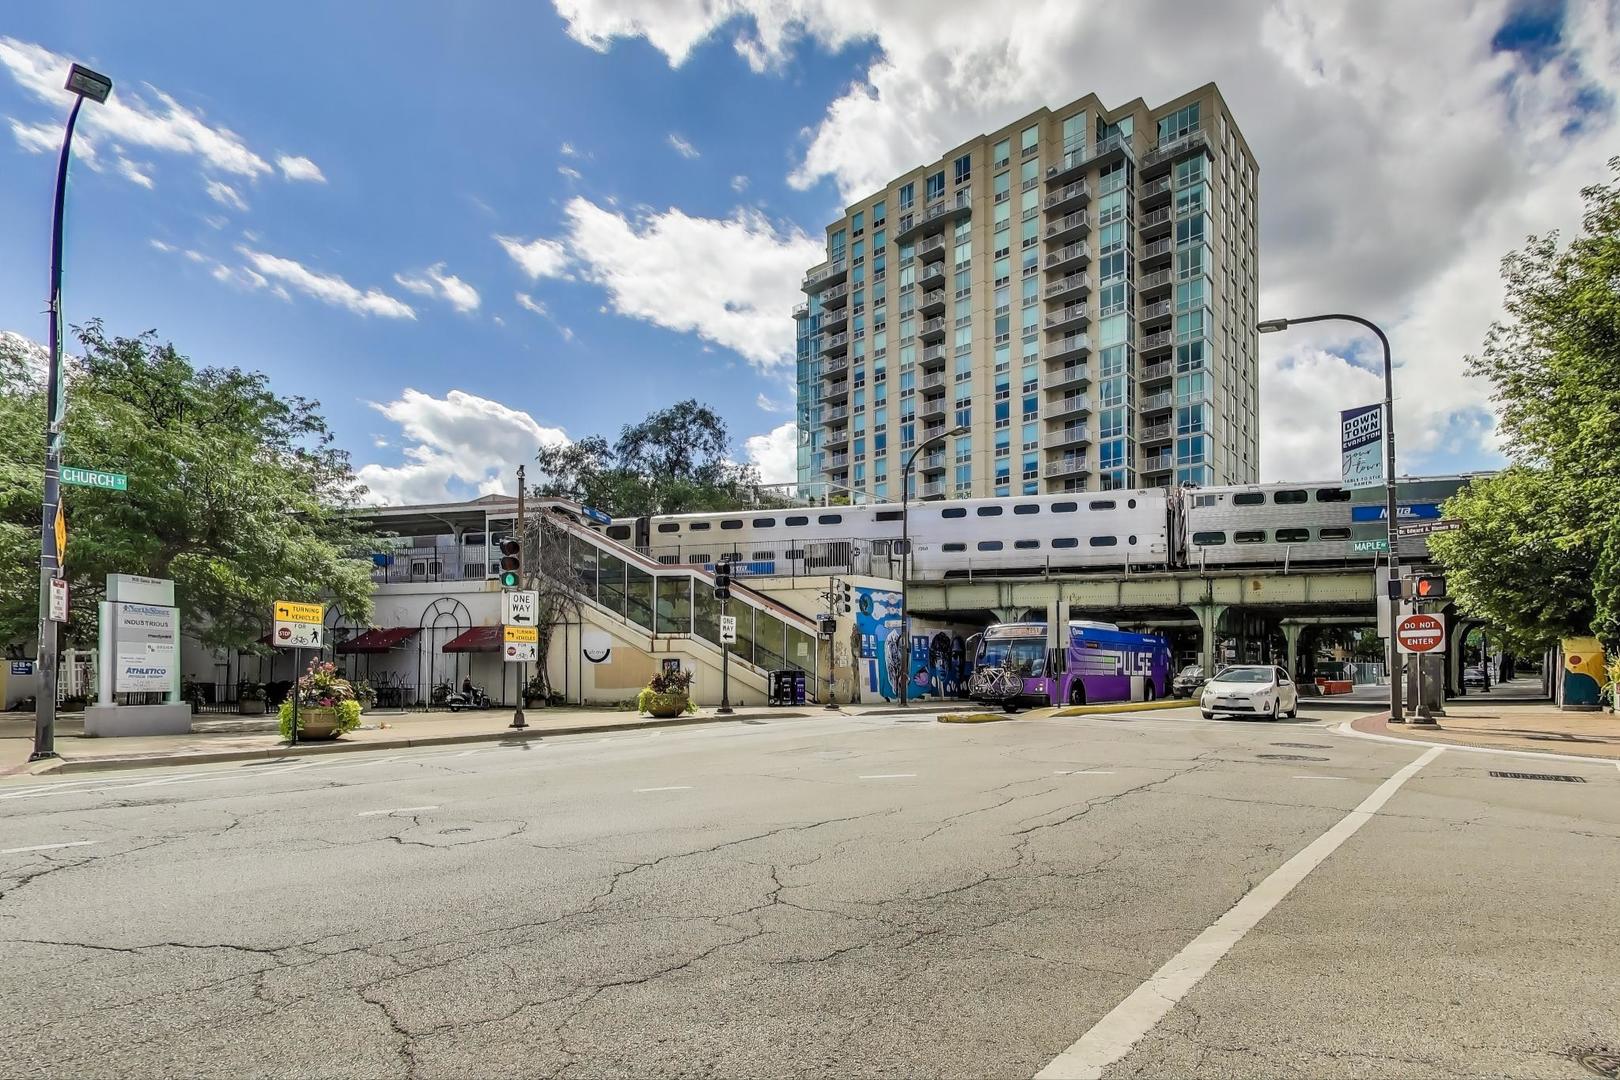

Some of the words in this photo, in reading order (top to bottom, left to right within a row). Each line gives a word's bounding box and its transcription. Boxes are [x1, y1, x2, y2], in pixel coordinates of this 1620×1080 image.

[1345, 411, 1378, 431] DOWN
[1345, 421, 1378, 440] TOWN
[1343, 431, 1380, 449] EVANSTON
[62, 469, 114, 487] CHURCH
[1380, 507, 1411, 519] Mtra
[1354, 541, 1381, 552] MAPLE
[514, 595, 531, 604] ONE
[293, 606, 320, 614] TURNING
[513, 604, 531, 613] WAY
[291, 613, 320, 622] VEHICLES
[722, 617, 734, 625] ONE
[123, 619, 169, 628] INDUSTRIOUS
[1420, 621, 1436, 629] NOT
[1407, 638, 1434, 646] ENTER
[1114, 649, 1153, 676] PULSE
[125, 667, 167, 675] ATHLETICO
